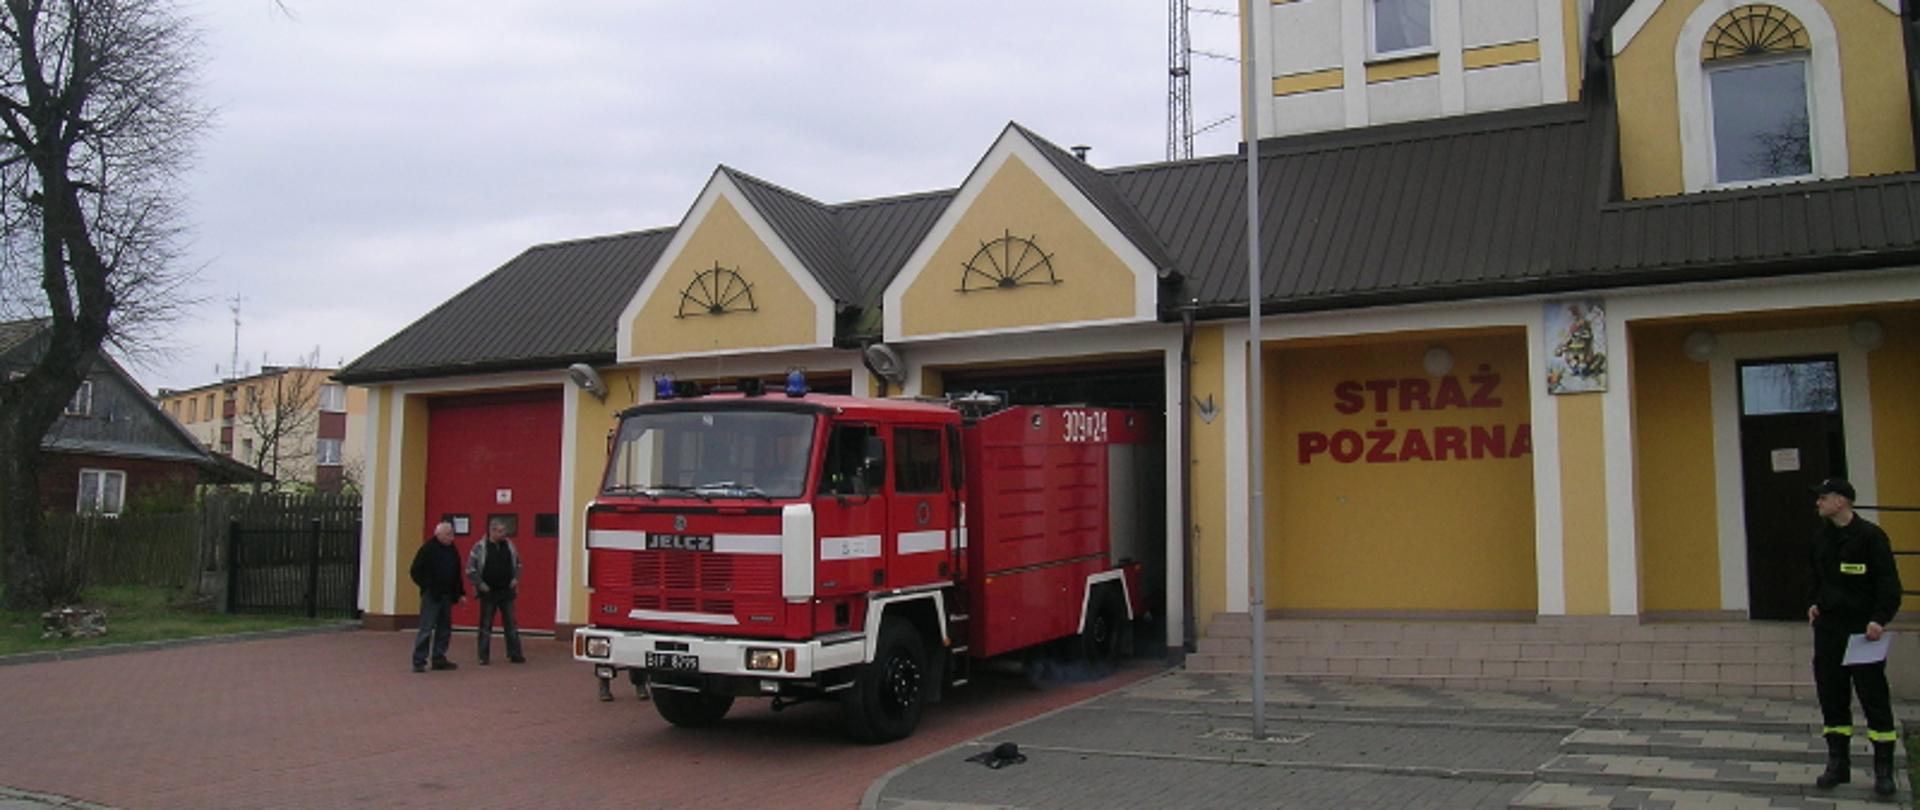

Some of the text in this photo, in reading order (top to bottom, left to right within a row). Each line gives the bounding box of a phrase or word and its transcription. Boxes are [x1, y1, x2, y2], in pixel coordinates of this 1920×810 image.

[1333, 363, 1503, 415] STRAŻ
[1298, 419, 1533, 465] POŻARNA
[648, 534, 711, 550] JELCZ
